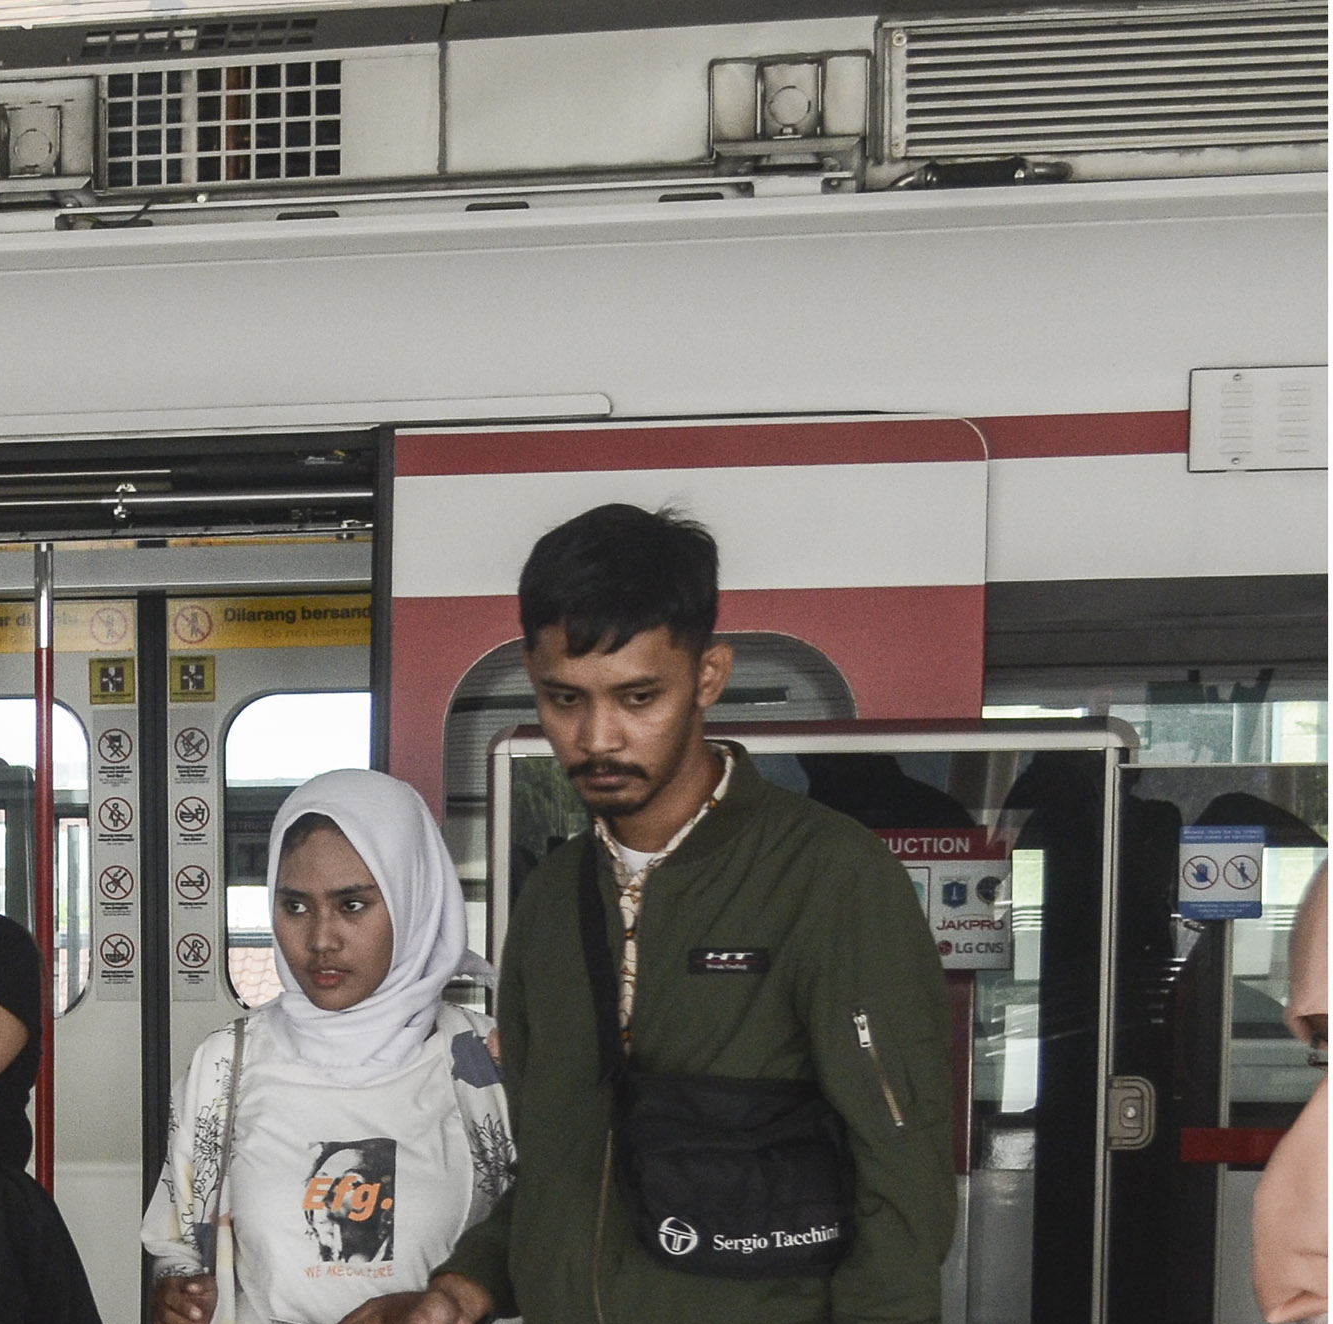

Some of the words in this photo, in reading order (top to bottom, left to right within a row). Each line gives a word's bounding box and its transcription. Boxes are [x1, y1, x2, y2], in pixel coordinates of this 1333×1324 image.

[15, 612, 31, 626] di
[224, 607, 296, 624] Dilarang
[884, 837, 970, 853] UCTION
[936, 917, 1004, 930] JAKPRO
[955, 942, 973, 954] LG
[975, 942, 1004, 954] CNS
[302, 1175, 393, 1222] Efg.
[712, 1234, 769, 1254] Sergio
[770, 1221, 840, 1249] Tacchini
